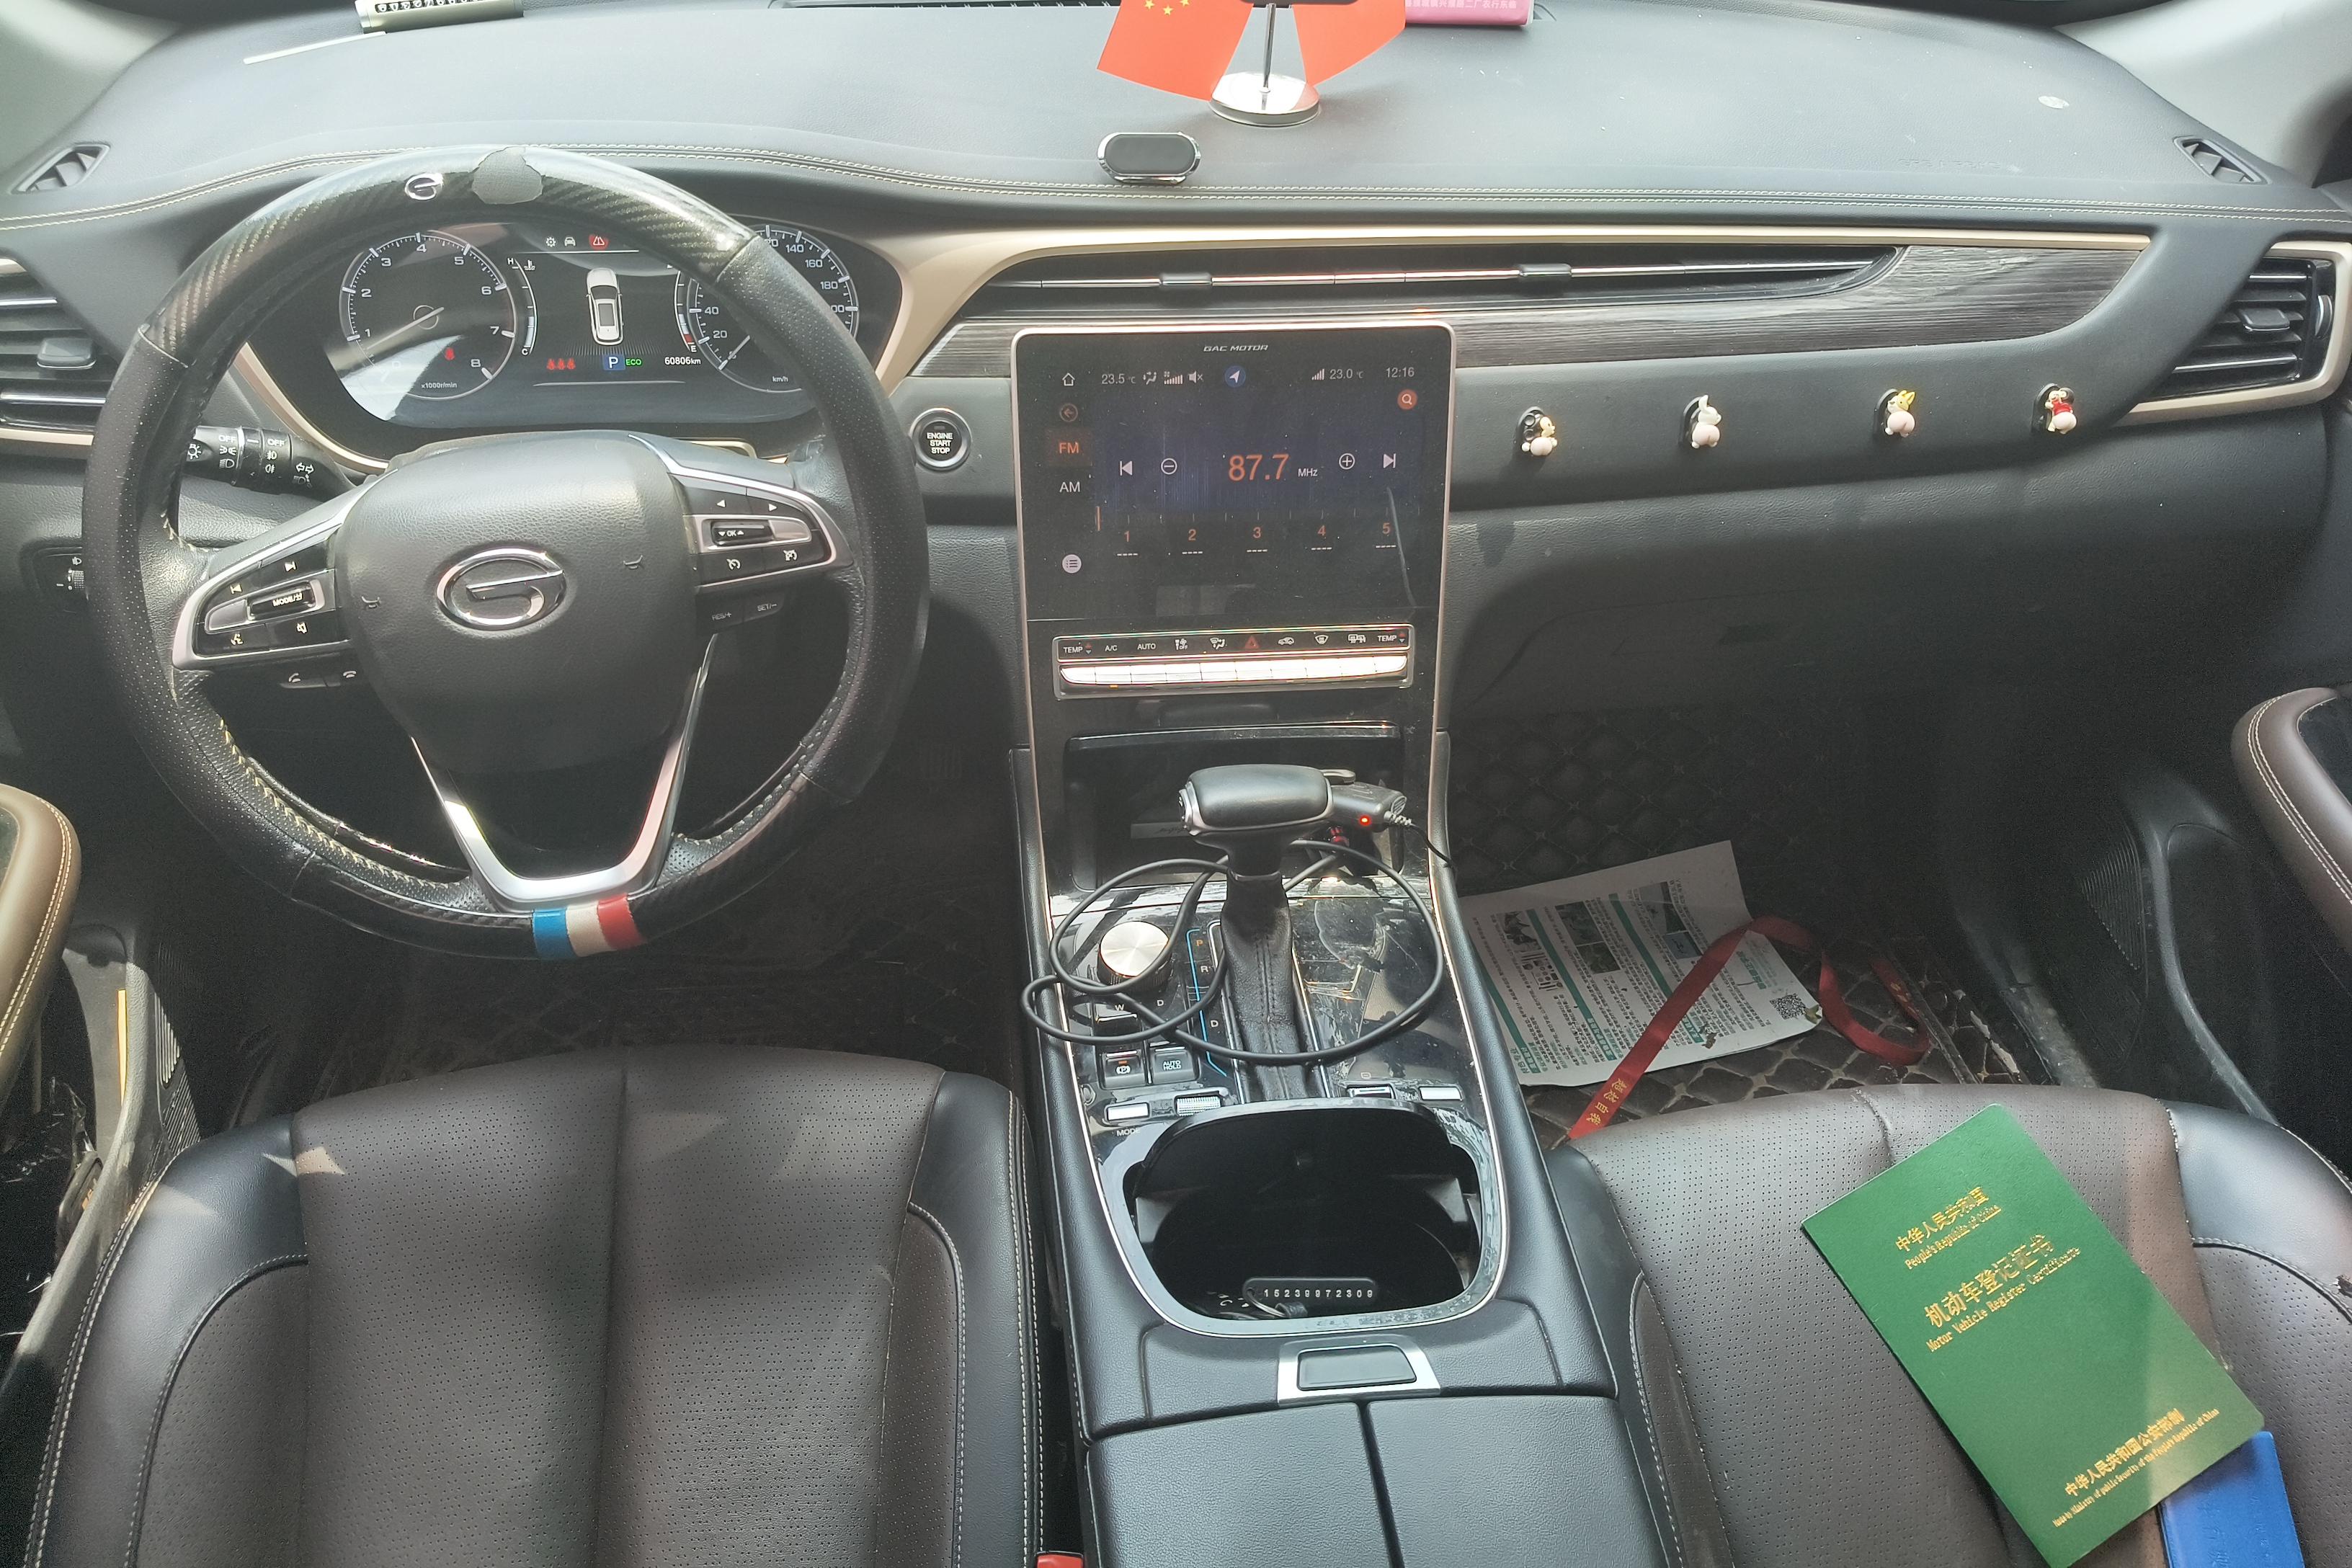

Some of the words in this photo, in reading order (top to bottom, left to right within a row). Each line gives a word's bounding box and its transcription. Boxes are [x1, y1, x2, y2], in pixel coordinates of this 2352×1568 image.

[416, 244, 427, 252] 4
[785, 244, 804, 253] 140
[381, 257, 391, 267] 3
[454, 257, 464, 265] 5
[805, 259, 823, 268] 160
[481, 286, 491, 295] 6
[820, 281, 839, 290] 180
[361, 288, 372, 298] 2
[704, 306, 719, 315] 40
[365, 328, 371, 337] 1
[490, 326, 499, 334] 7
[713, 329, 728, 339] 20
[471, 359, 481, 368] 8
[608, 356, 619, 368] P
[664, 357, 701, 365] 60806km
[1329, 368, 1353, 380] 23.0
[1386, 366, 1415, 378] 12:16
[1101, 373, 1126, 384] 23.5
[218, 434, 237, 443] OFF
[267, 438, 285, 447] OFF
[1059, 441, 1079, 454] FM
[1228, 453, 1290, 481] 87.7
[1298, 467, 1318, 477] MHz
[1059, 481, 1081, 493] AM
[1252, 527, 1262, 539] 3
[1317, 525, 1327, 537] 4
[1382, 522, 1391, 535] 5
[1123, 530, 1131, 543] 1
[1188, 529, 1197, 541] 2
[1116, 1128, 1141, 1137] MODE
[1897, 1188, 1988, 1251] 中华人民共和国
[1925, 1235, 2053, 1327] 机动车登记证书
[1926, 1330, 1954, 1352] Motor
[1953, 1310, 1987, 1333] Vehicle
[1987, 1283, 2025, 1311] Register
